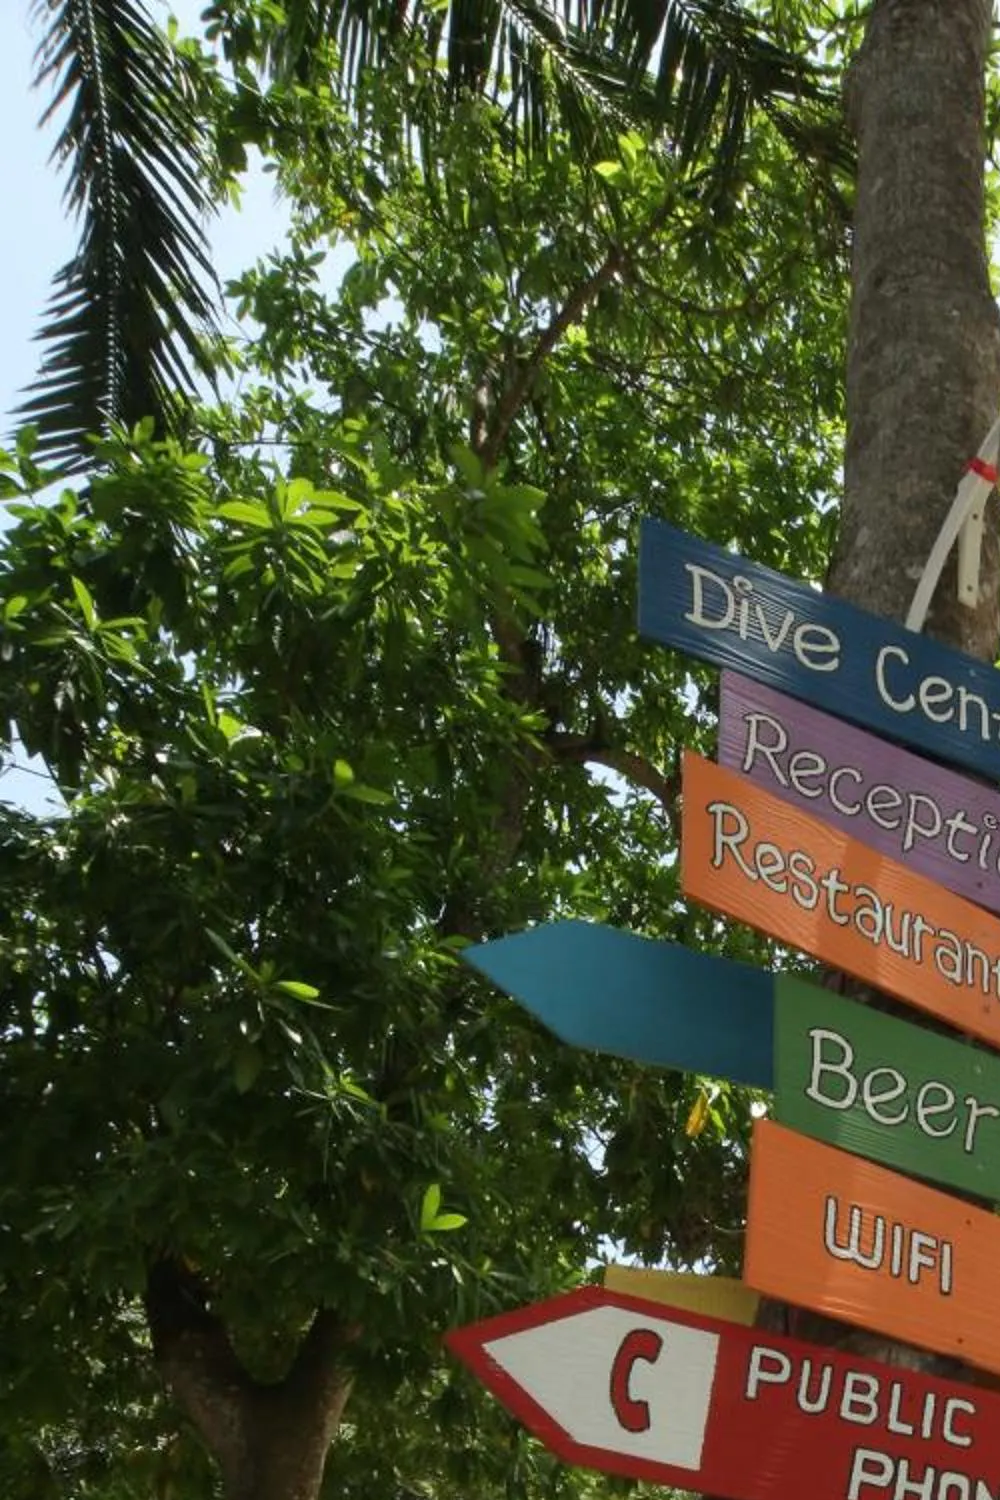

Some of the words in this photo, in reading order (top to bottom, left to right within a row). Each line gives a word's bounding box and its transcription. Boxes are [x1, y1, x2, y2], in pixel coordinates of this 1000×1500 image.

[684, 563, 841, 672] Dive
[804, 1028, 1000, 1153] Beer
[824, 1196, 954, 1295] WIFI
[745, 1344, 977, 1447] PUBLIC
